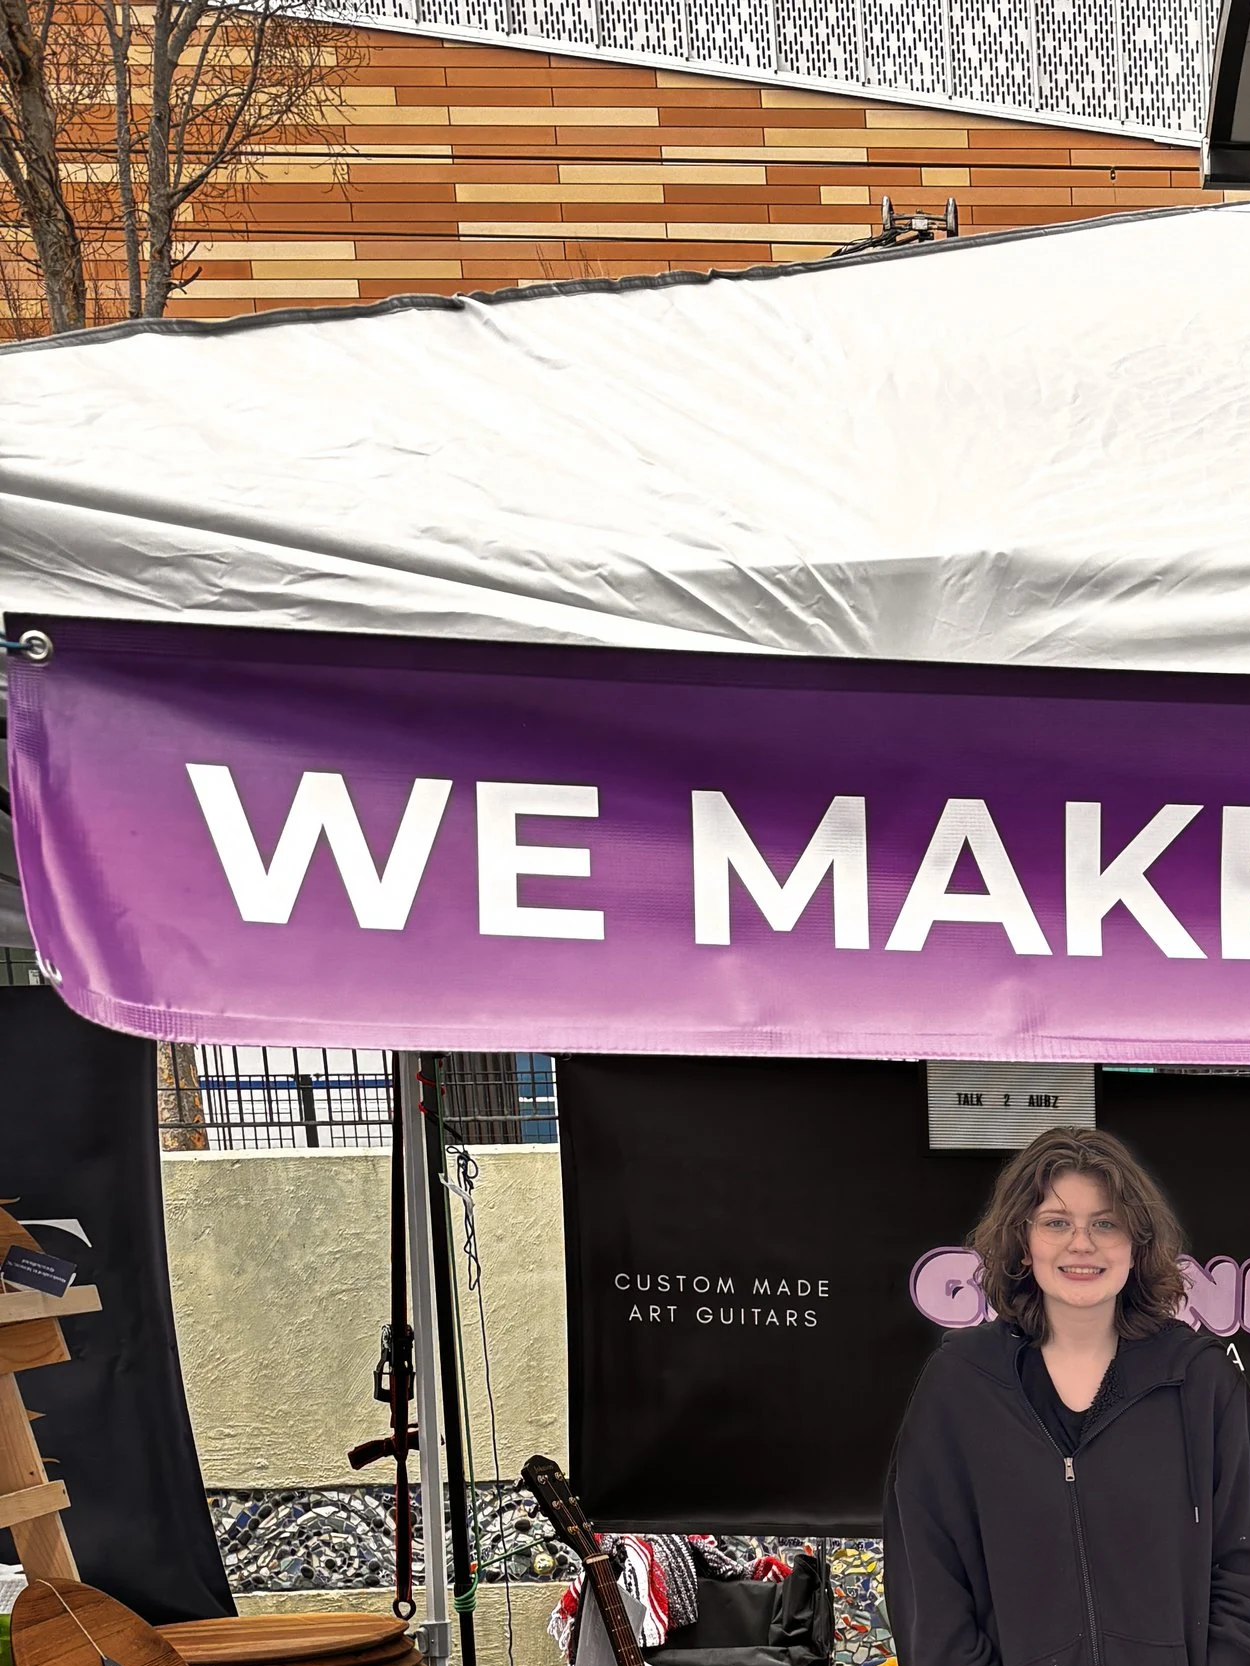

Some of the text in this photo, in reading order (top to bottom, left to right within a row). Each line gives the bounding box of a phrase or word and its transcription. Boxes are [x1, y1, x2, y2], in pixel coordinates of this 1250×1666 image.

[186, 763, 604, 941] WE
[956, 1093, 1060, 1108] TALK 2 AUBZ
[614, 1273, 830, 1297] CUSTOM MADE
[628, 1304, 819, 1327] ART GUITARS
